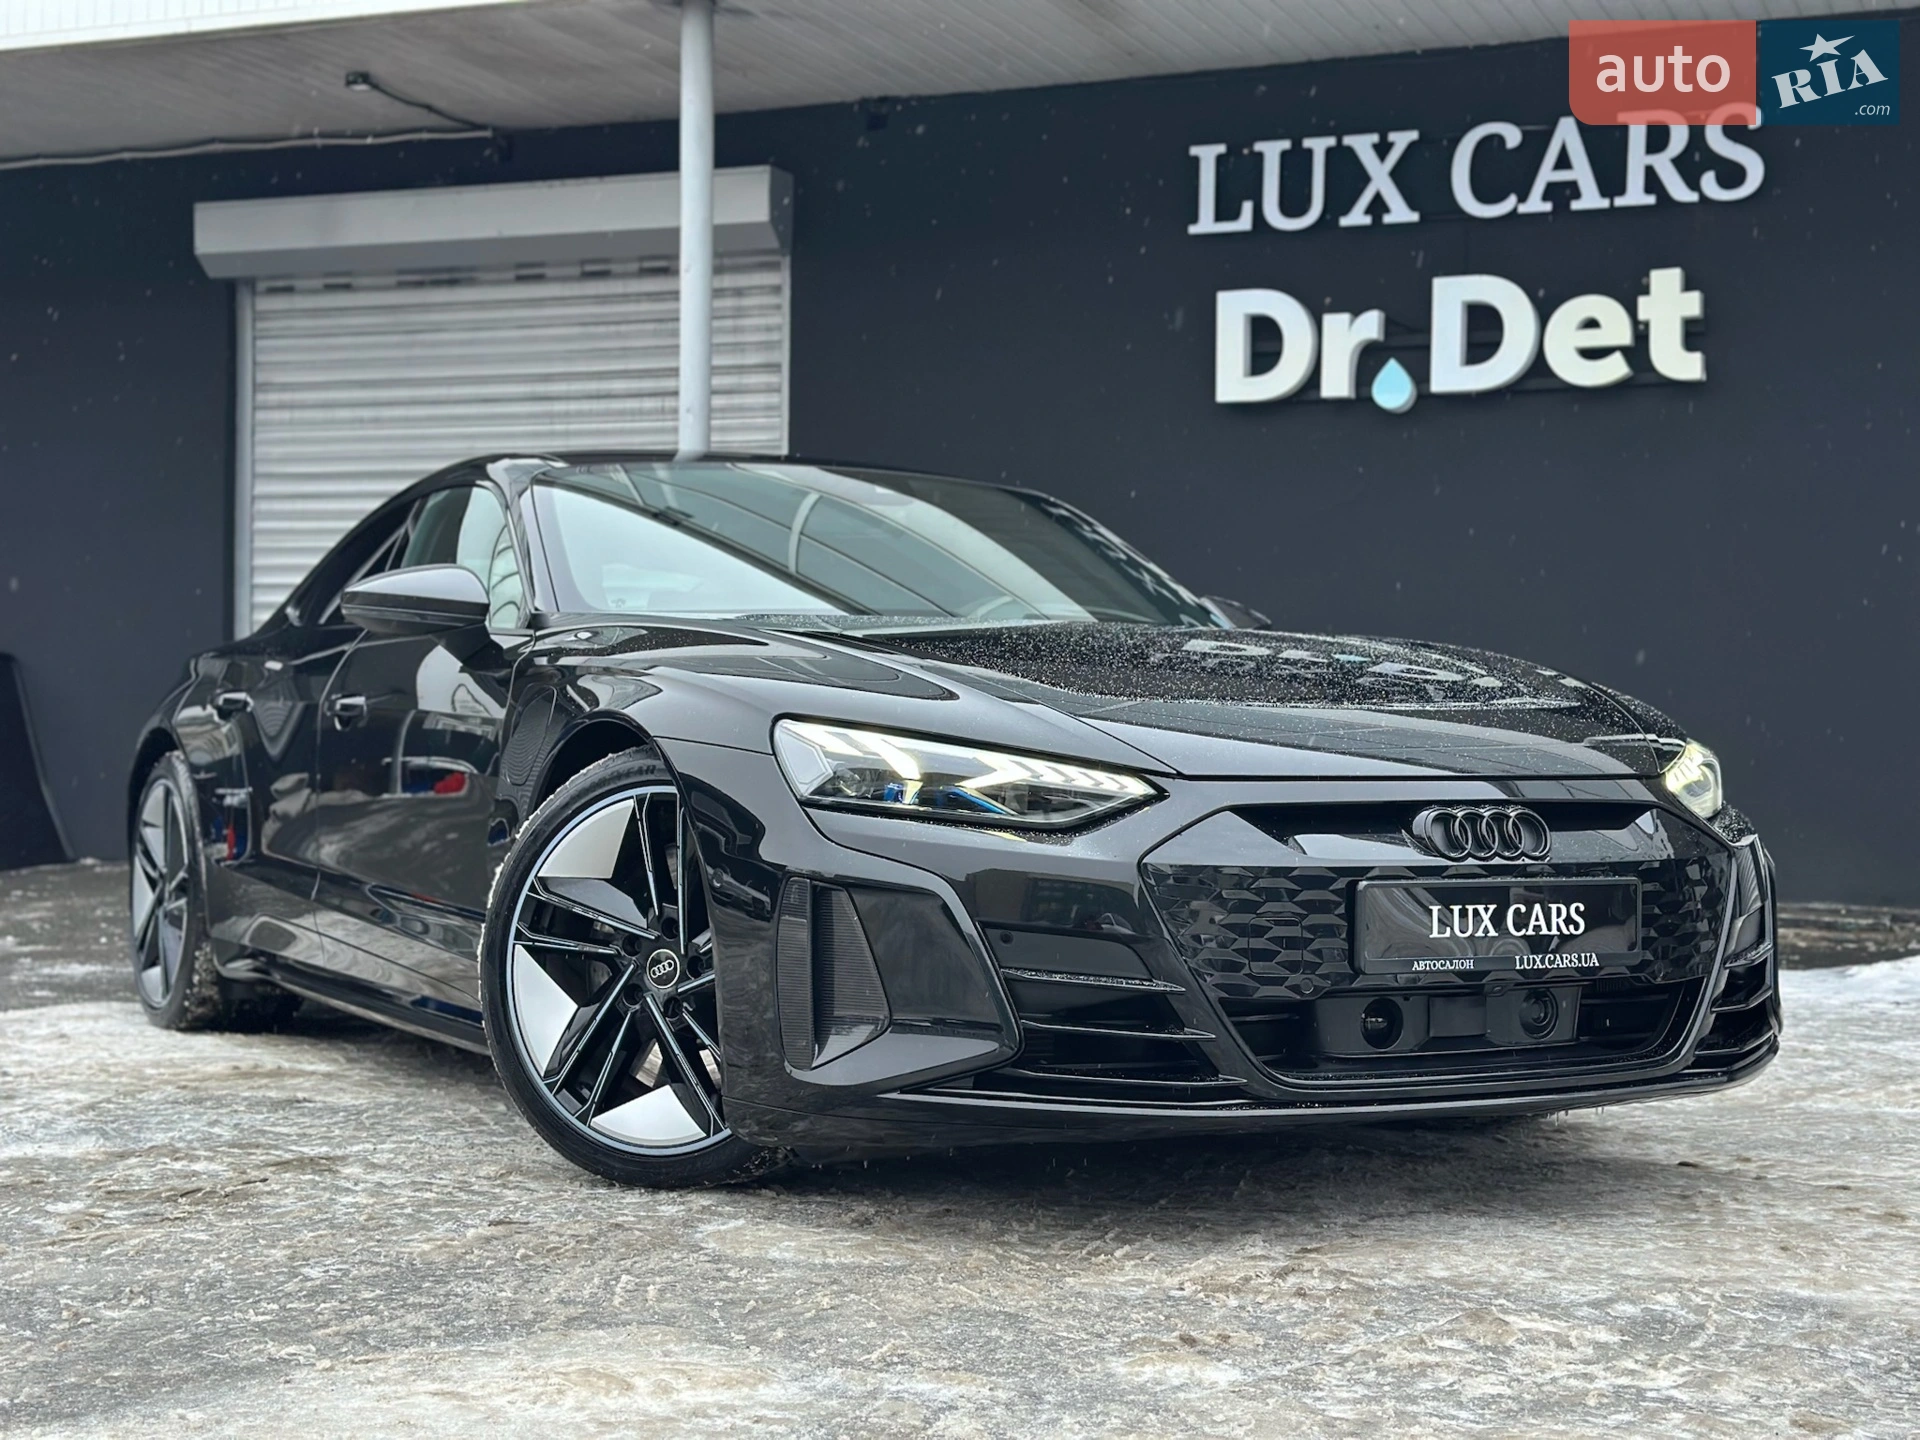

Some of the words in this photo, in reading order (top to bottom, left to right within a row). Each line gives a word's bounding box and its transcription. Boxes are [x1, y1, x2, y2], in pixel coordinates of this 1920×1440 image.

[1187, 129, 1420, 235] LUX
[1450, 102, 1766, 220] CARS
[1429, 904, 1499, 939] LUX
[1506, 902, 1586, 937] CARS
[1412, 959, 1475, 971] АВТОСАЛОН
[1514, 953, 1600, 970] LUX.CARS.UA
